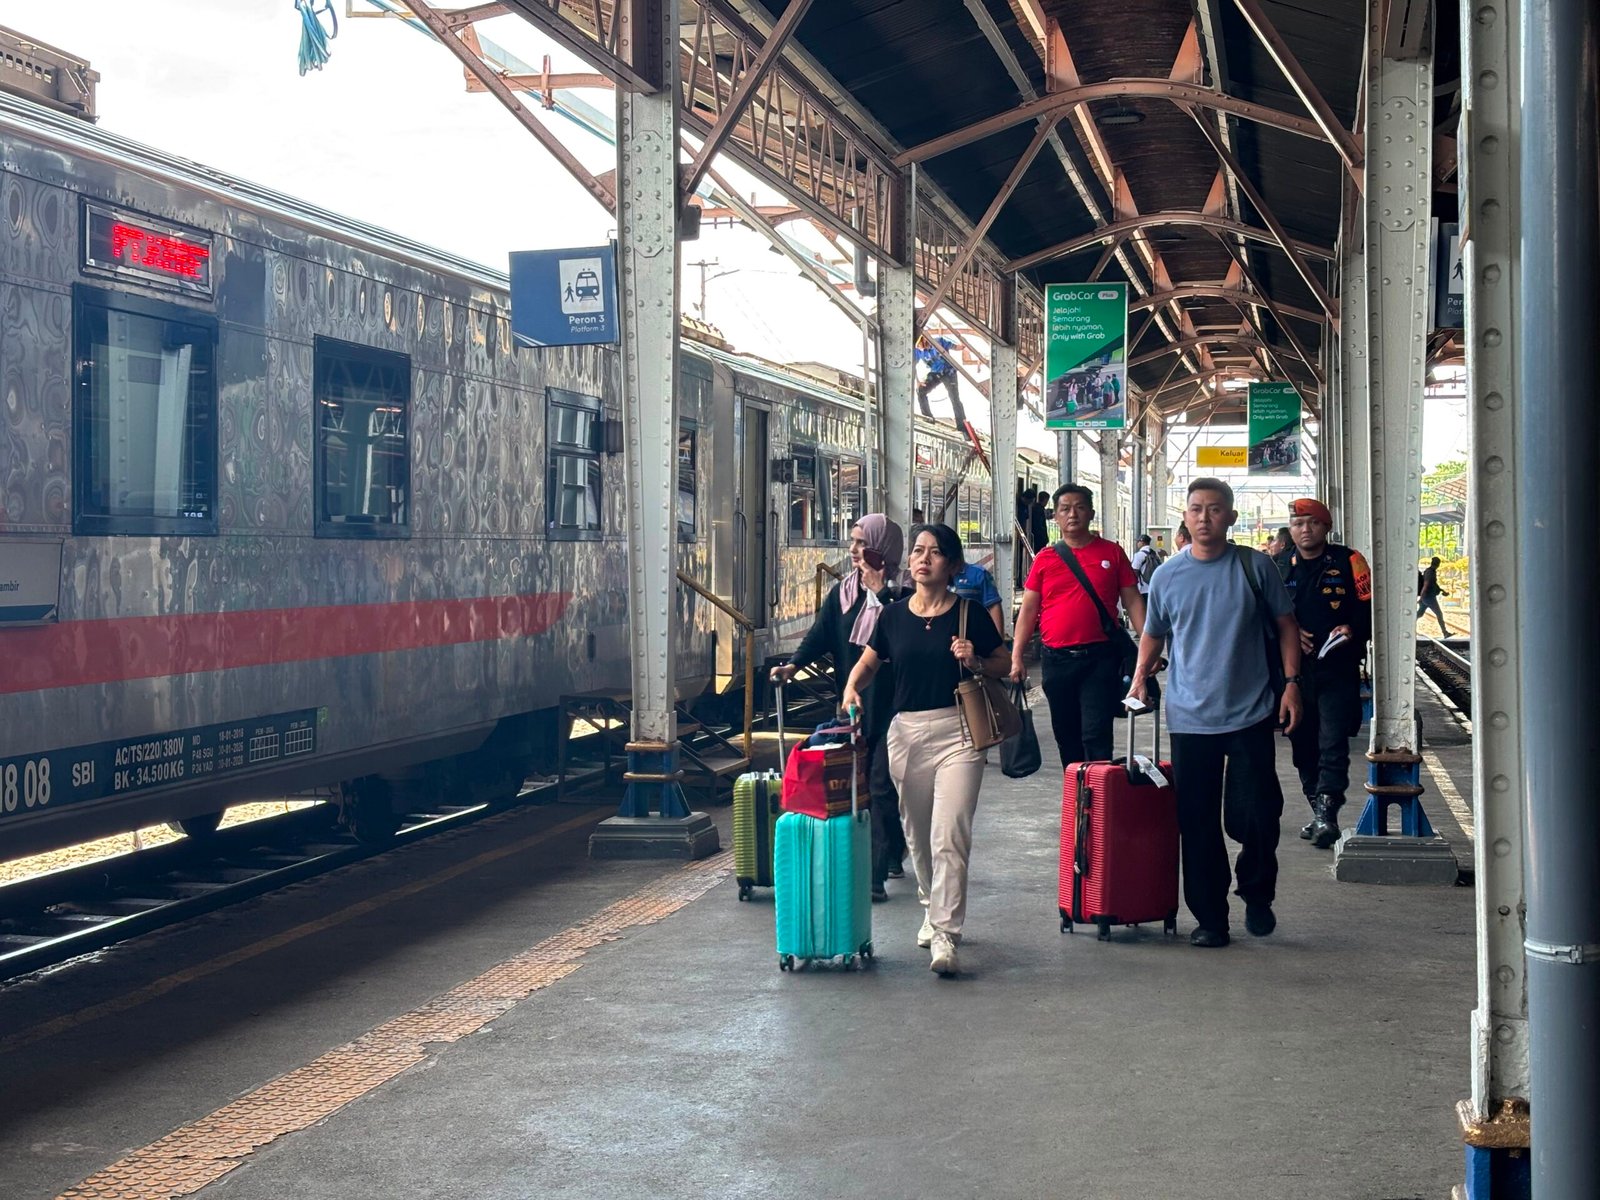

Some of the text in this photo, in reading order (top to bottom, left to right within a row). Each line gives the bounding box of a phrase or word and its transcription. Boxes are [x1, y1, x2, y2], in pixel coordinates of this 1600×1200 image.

[1053, 292, 1094, 300] GrabCar
[1448, 298, 1464, 306] Per
[1053, 306, 1081, 314] Jelajahi
[569, 314, 605, 325] Peron 3
[115, 736, 184, 767] AC/TS/220/380V
[24, 757, 50, 808] 08
[72, 760, 95, 787] SBI
[114, 771, 129, 790] BK
